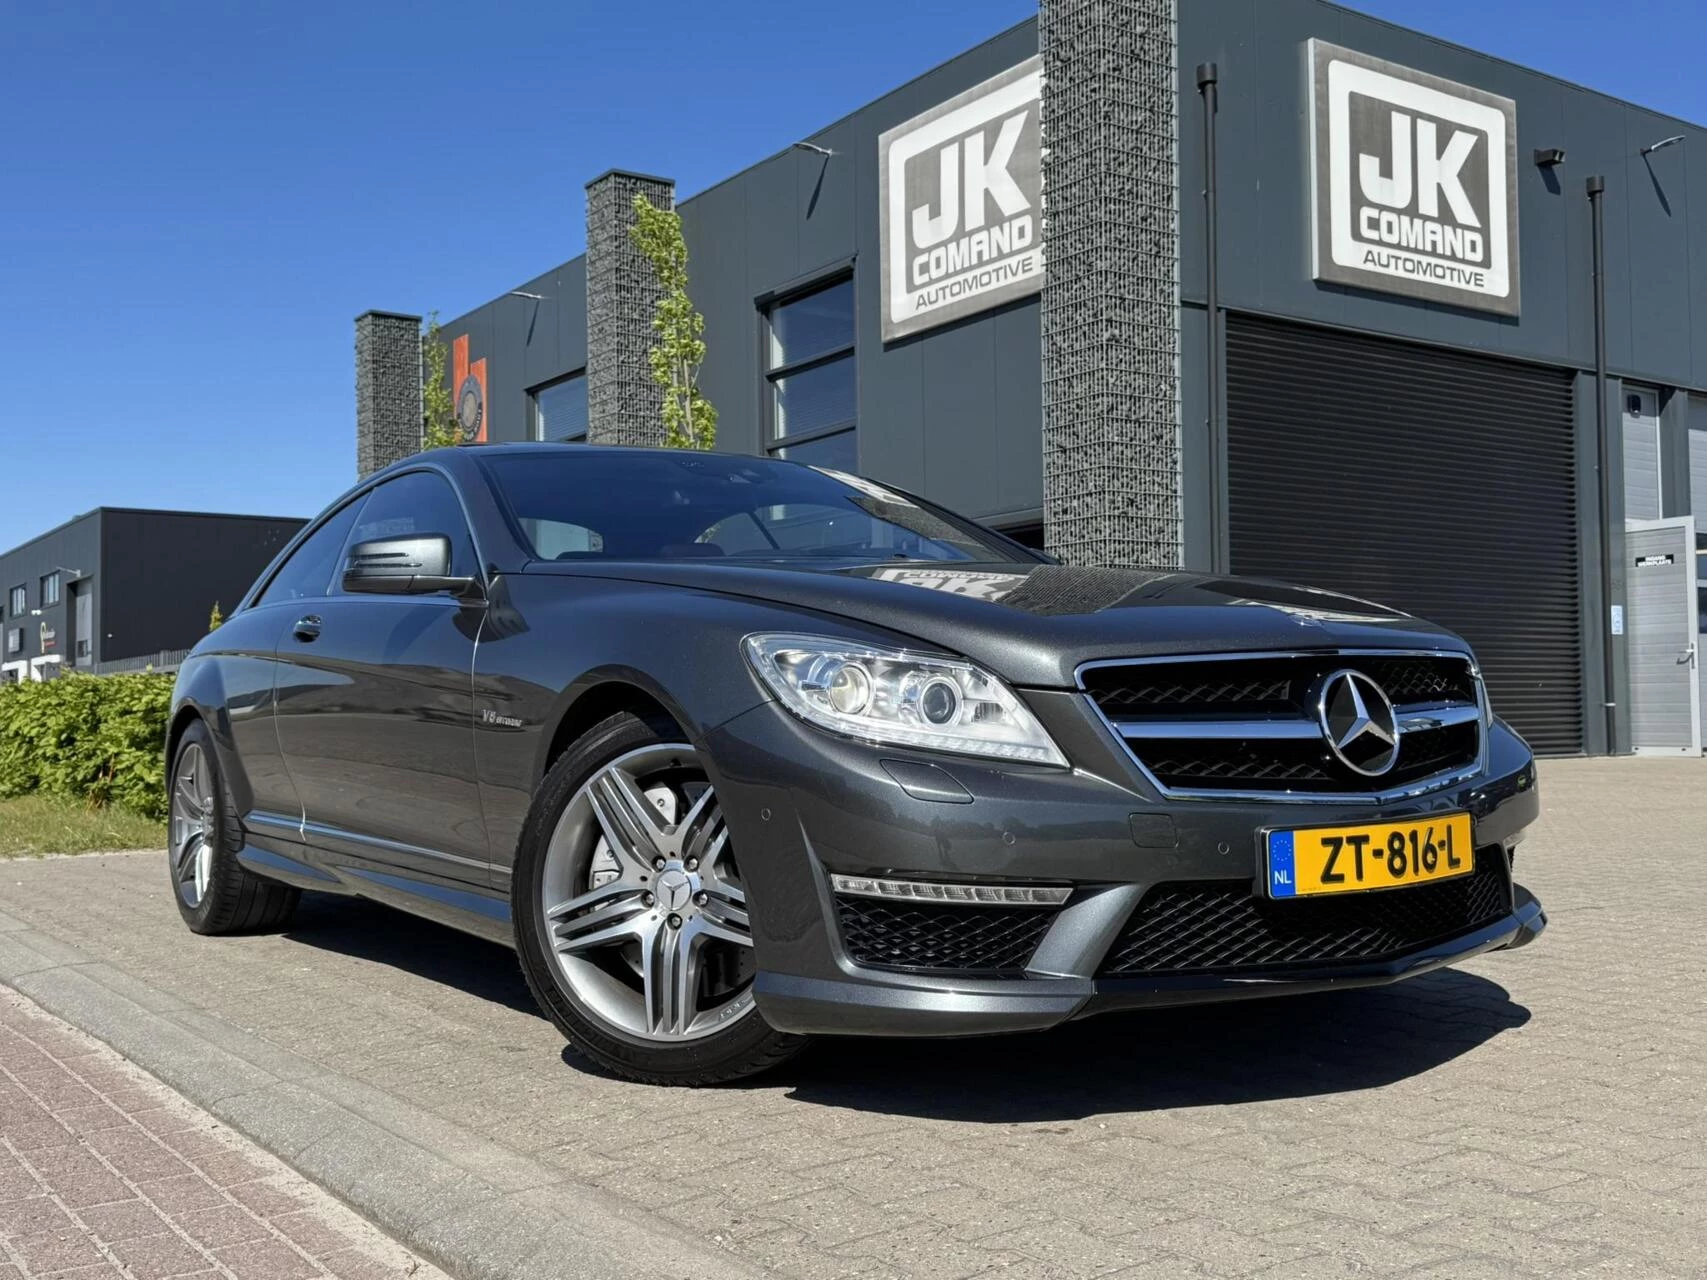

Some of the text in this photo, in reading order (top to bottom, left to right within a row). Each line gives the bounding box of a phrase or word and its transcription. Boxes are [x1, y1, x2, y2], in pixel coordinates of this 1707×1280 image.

[912, 110, 1031, 249] JK
[1359, 111, 1482, 228] JK
[913, 214, 1033, 286] COMAND
[1359, 206, 1483, 262] COMAND
[915, 255, 1033, 311] AUTOMOTIVE
[1363, 250, 1484, 287] AUTOMOTIVE
[1274, 869, 1292, 885] NL
[1320, 824, 1461, 884] ZT-816-L
